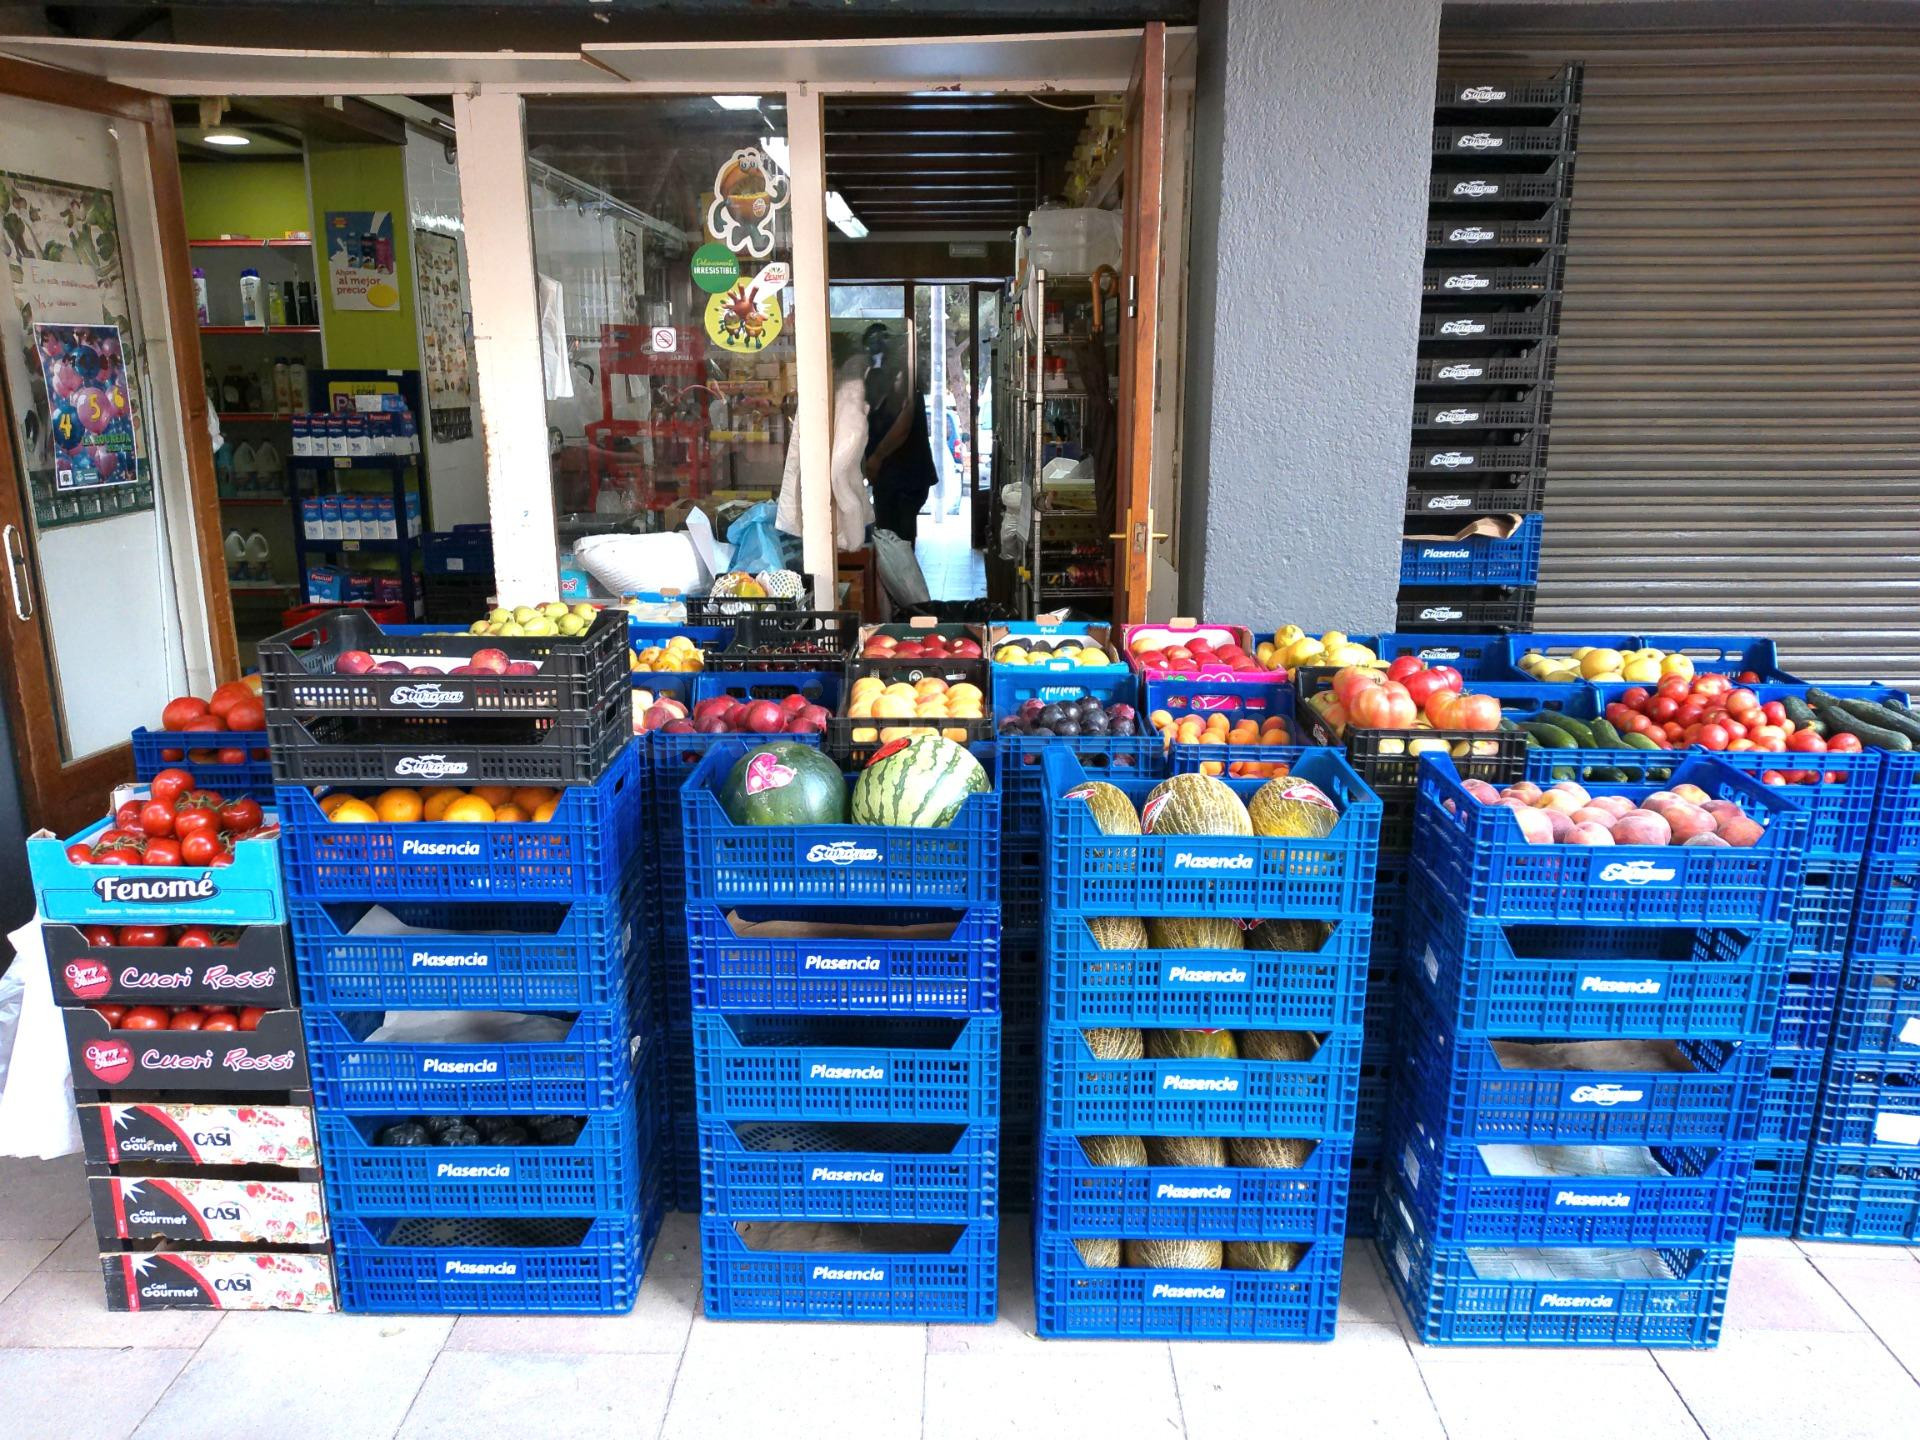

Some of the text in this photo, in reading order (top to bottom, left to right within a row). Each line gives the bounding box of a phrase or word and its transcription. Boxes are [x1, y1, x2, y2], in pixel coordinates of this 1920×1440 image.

[694, 266, 738, 275] IRRESISTIBLE
[338, 277, 381, 286] al mejor
[336, 287, 367, 295] precio
[59, 385, 125, 440] 4 5 6
[1423, 548, 1470, 558] Plasencia
[402, 839, 480, 855] Plasencia
[1174, 853, 1254, 869] Plasencia
[97, 871, 214, 902] Fenomé
[412, 952, 488, 967] Plasencia
[805, 955, 881, 971] Plasencia
[119, 965, 276, 989] Cuori Rossi
[1168, 966, 1247, 983] Plasencia
[1581, 976, 1661, 994] Plasencia
[141, 1048, 296, 1072] Cuori Rossi
[423, 1058, 498, 1073] Plasencia
[810, 1064, 884, 1080] Plasencia
[1163, 1075, 1239, 1092] Plasencia
[120, 1141, 178, 1152] Gourmet
[130, 1136, 146, 1144] Casi
[193, 1132, 231, 1147] CASI
[437, 1163, 510, 1177] Plasencia
[811, 1167, 884, 1183] Plasencia
[1157, 1184, 1232, 1199] Plasencia
[1555, 1191, 1631, 1207] Plasencia
[129, 1213, 187, 1225] Gourmet
[139, 1209, 156, 1217] Casi
[203, 1206, 241, 1220] CASI
[445, 1261, 517, 1275] Plasencia
[812, 1266, 885, 1281] Plasencia
[141, 1287, 199, 1298] Gourmet
[214, 1278, 252, 1292] CASI
[1152, 1284, 1226, 1299] Plasencia
[1540, 1293, 1614, 1308] Plasencia
